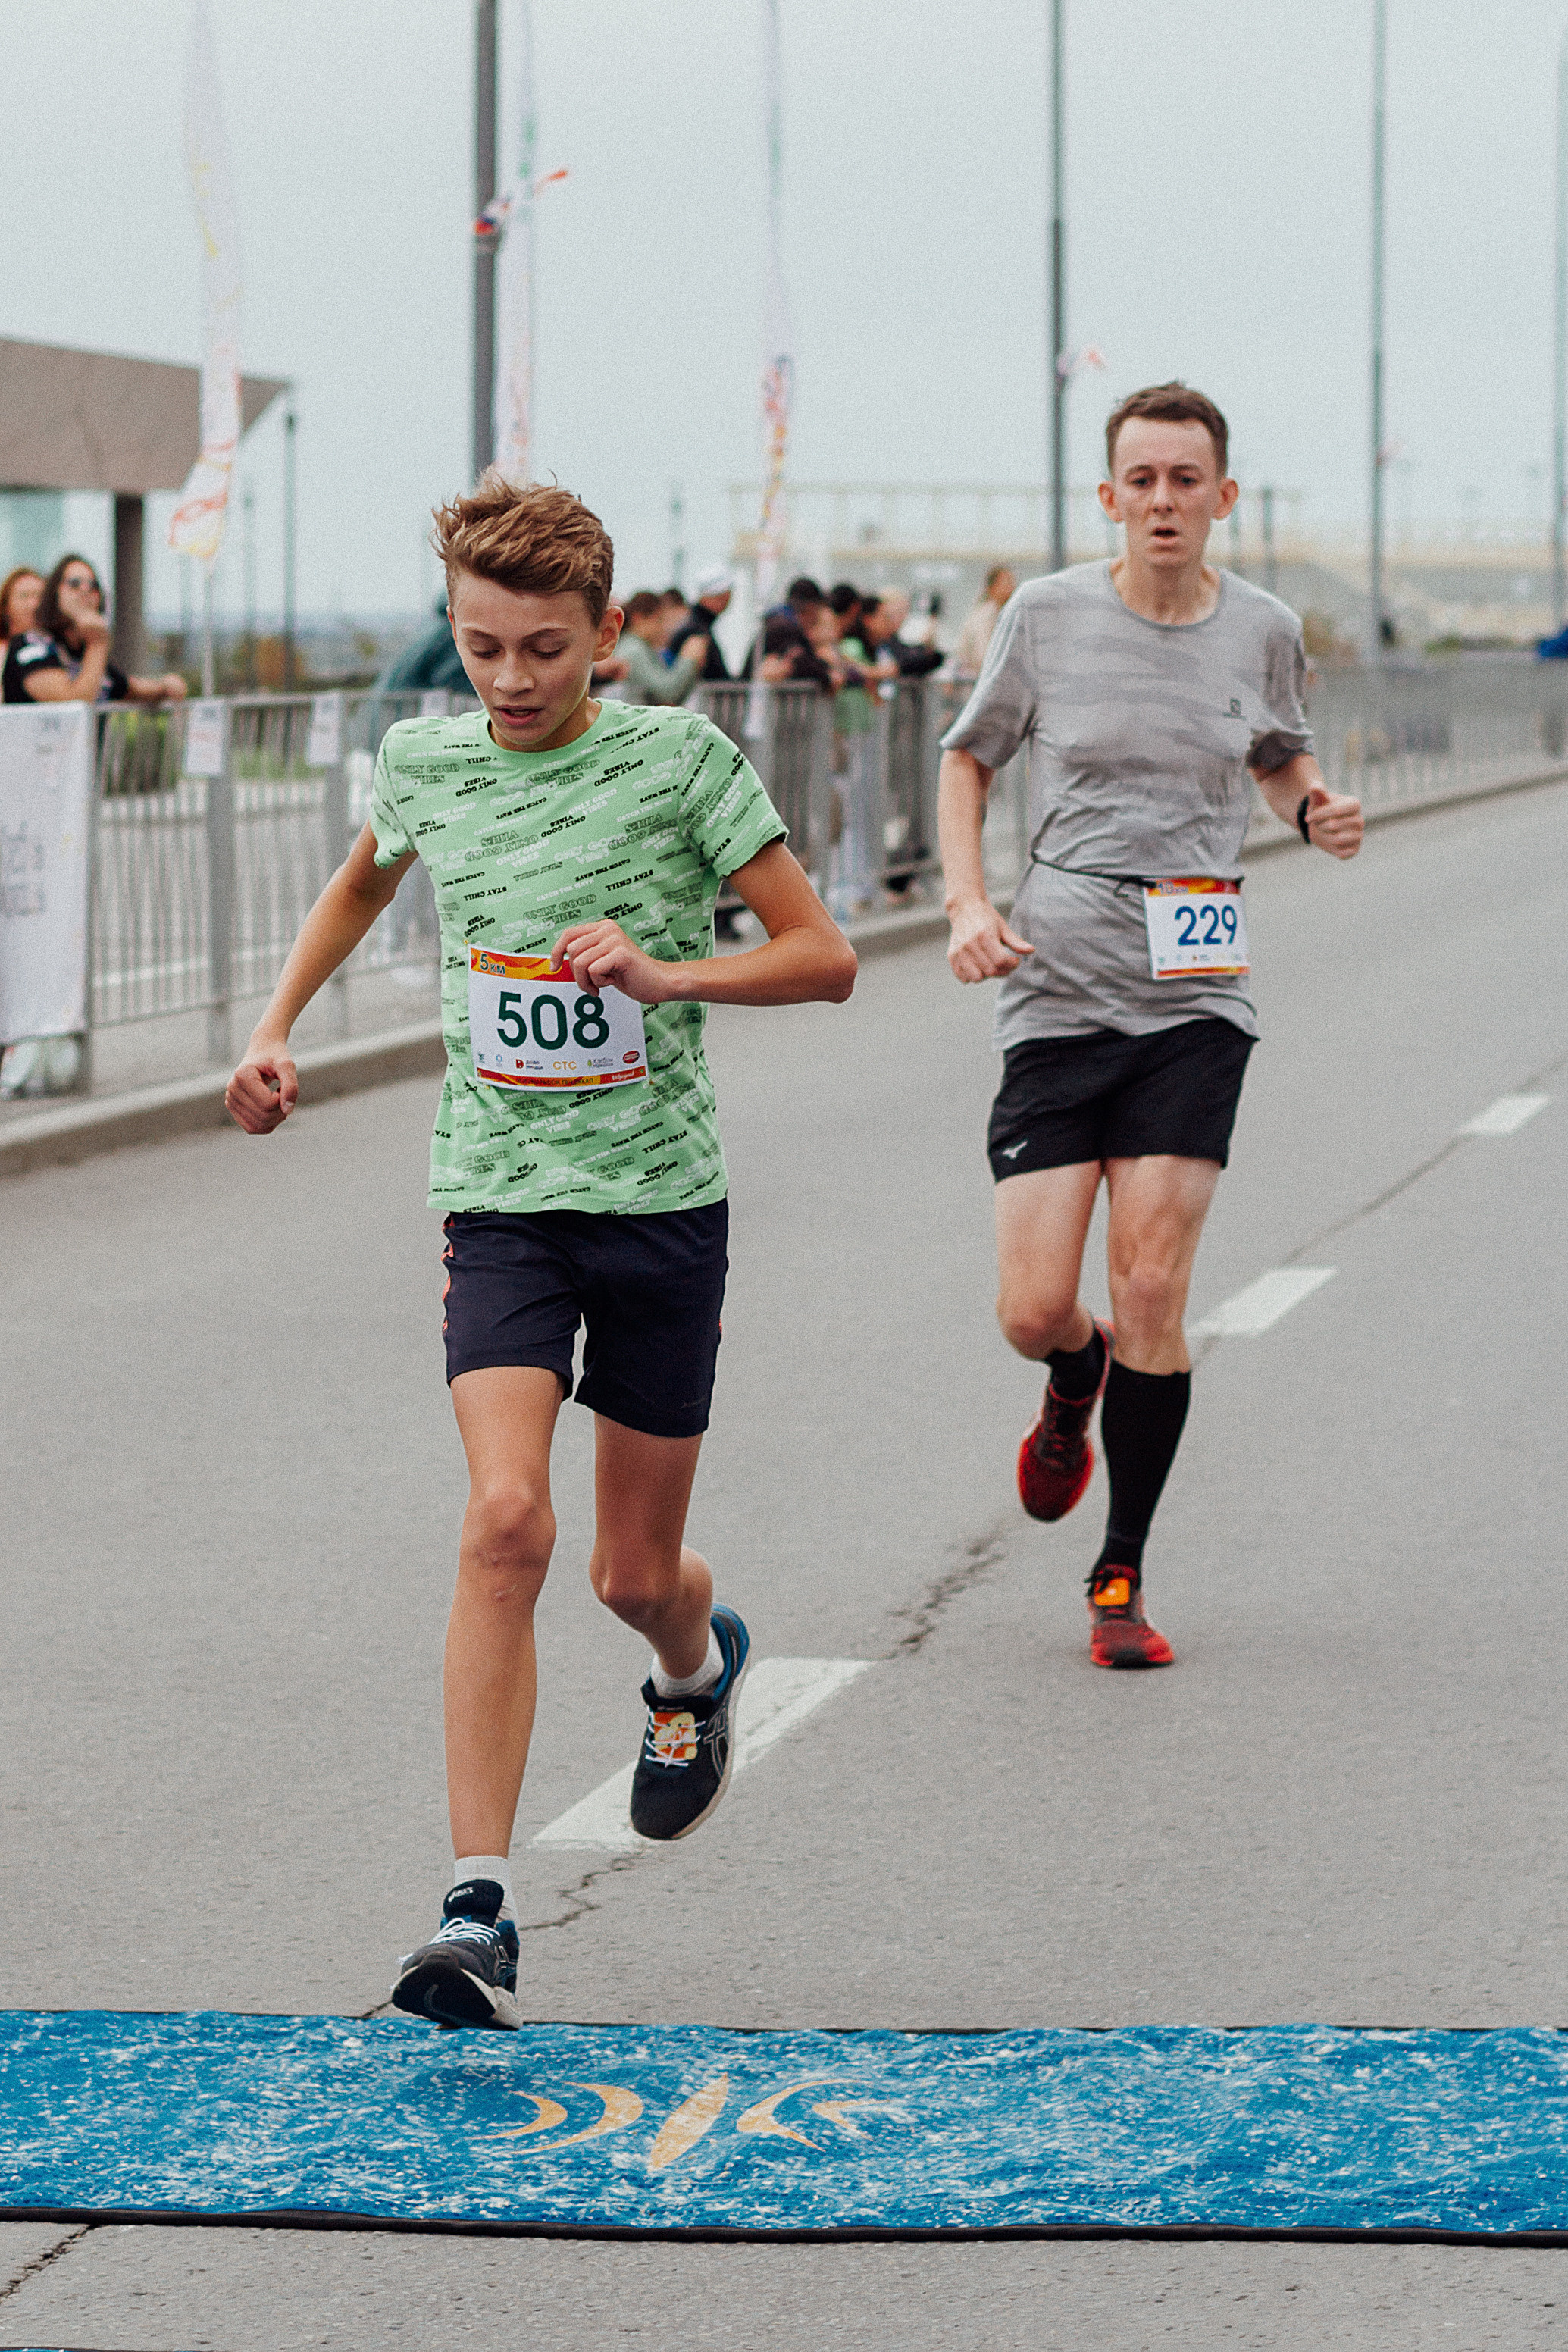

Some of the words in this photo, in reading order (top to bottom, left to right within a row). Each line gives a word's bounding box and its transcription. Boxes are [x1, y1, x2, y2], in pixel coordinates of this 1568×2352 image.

[602, 735, 615, 744] THE
[615, 727, 638, 739] CATCH
[637, 726, 659, 742] STAY
[699, 742, 715, 765] CATCH
[466, 756, 491, 765] CHILL
[621, 759, 643, 775] ONLY
[603, 760, 631, 776] VIBES
[693, 764, 703, 778] THE
[464, 776, 487, 787] VIBES
[479, 778, 498, 790] ONLY
[594, 772, 620, 787] GOOD
[456, 787, 477, 797] GOOD
[659, 787, 672, 796] THE
[680, 778, 695, 797] WAVE
[592, 788, 618, 803] GOOD
[639, 791, 659, 803] WAVE
[513, 805, 526, 814] THE
[526, 797, 547, 809] CATCH
[496, 809, 512, 820] WAVE
[430, 823, 446, 833] ONLY
[549, 815, 574, 828] VIBES
[565, 816, 586, 830] ONLY
[541, 825, 563, 837] GOOD
[496, 853, 521, 866] ONLY
[522, 838, 551, 855] GOOD
[609, 857, 631, 870] CATCH
[465, 871, 485, 881] CATCH
[574, 872, 595, 882] WAVE
[594, 866, 609, 875] THE
[634, 869, 654, 882] STAY
[487, 886, 507, 897] STAY
[605, 878, 632, 892] CHILL
[1158, 881, 1174, 894] 10
[463, 891, 486, 902] CHILL
[603, 902, 630, 918] VIBES
[621, 901, 643, 916] ONLY
[480, 917, 496, 930] ONLY
[1175, 904, 1238, 946] 229
[525, 937, 547, 950] CATCH
[480, 953, 490, 971] 5
[497, 991, 610, 1051] 508
[568, 1097, 591, 1110] GOOD
[642, 1121, 664, 1135] CATCH
[629, 1131, 643, 1141] THE
[667, 1129, 688, 1145] STAY
[611, 1138, 631, 1148] WAVE
[642, 1139, 667, 1154] CHILL
[637, 1174, 662, 1187] GOOD
[570, 1185, 591, 1195] CATCH
